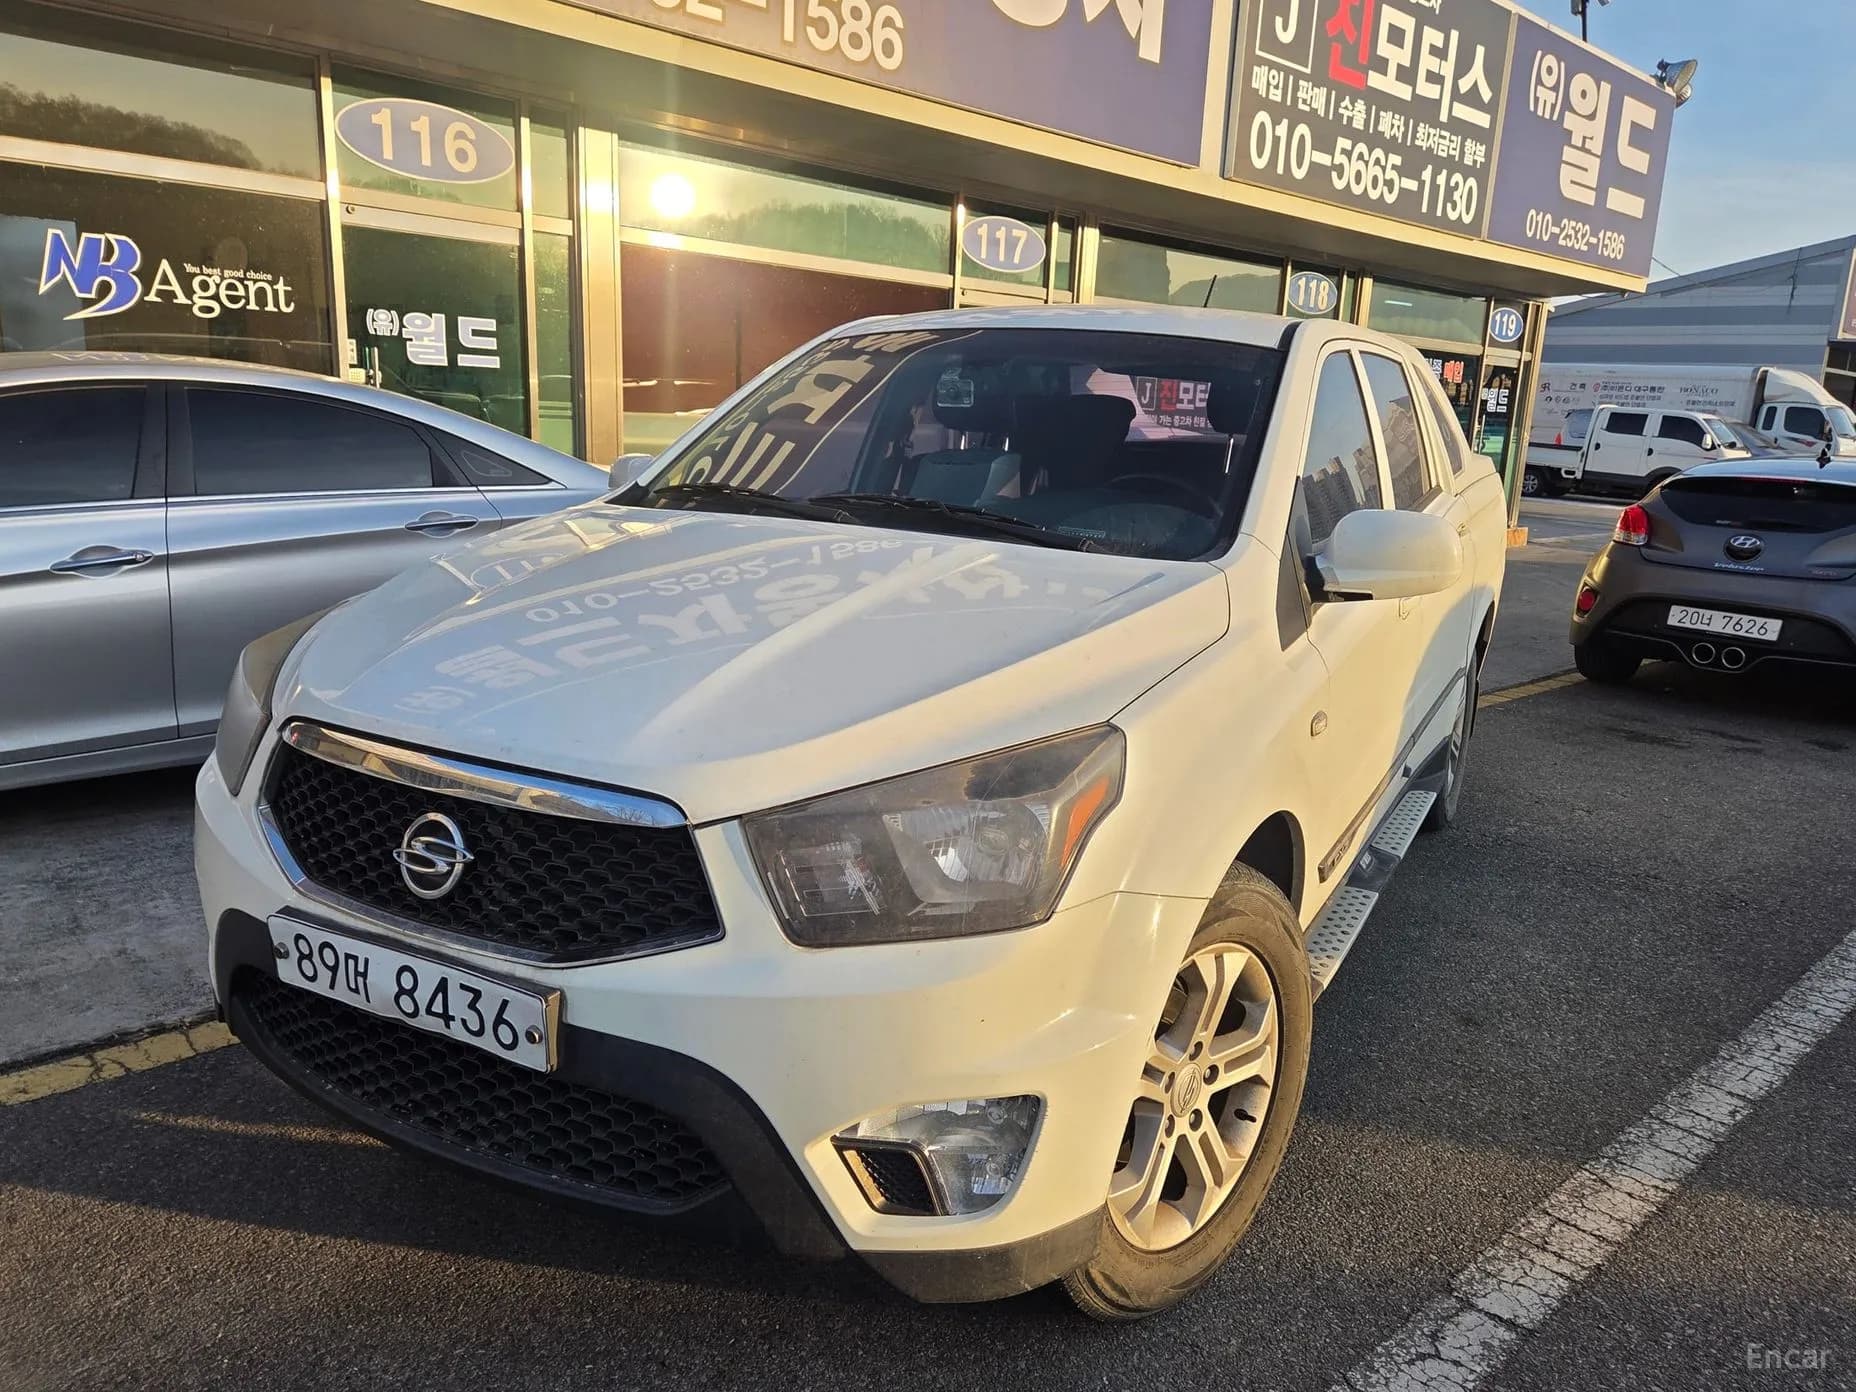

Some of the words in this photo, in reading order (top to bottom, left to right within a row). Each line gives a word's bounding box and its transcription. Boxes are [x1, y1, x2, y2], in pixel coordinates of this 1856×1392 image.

[654, 0, 904, 70] -1586
[1326, 0, 1493, 128] 진모터스
[371, 107, 478, 173] 116
[1251, 65, 1284, 103] 매입
[1297, 79, 1327, 118] 판매
[1338, 95, 1367, 130] 수출
[1378, 110, 1405, 143] 폐차
[1415, 123, 1462, 161] 최저금리
[1464, 138, 1487, 168] 할부
[1250, 110, 1478, 224] 010-5665-1130
[977, 223, 1028, 264] 117
[1526, 208, 1625, 260] 010-2532-1586
[144, 258, 295, 318] Agent
[183, 263, 200, 273] You
[202, 265, 221, 275] best
[223, 269, 244, 278] good
[246, 270, 273, 280] choice
[1298, 277, 1329, 310] 118
[366, 308, 500, 369] (유)월드
[1495, 312, 1516, 337] 119
[1721, 615, 1768, 636] 7626
[294, 933, 371, 1004] 89머
[394, 964, 519, 1051] 8436
